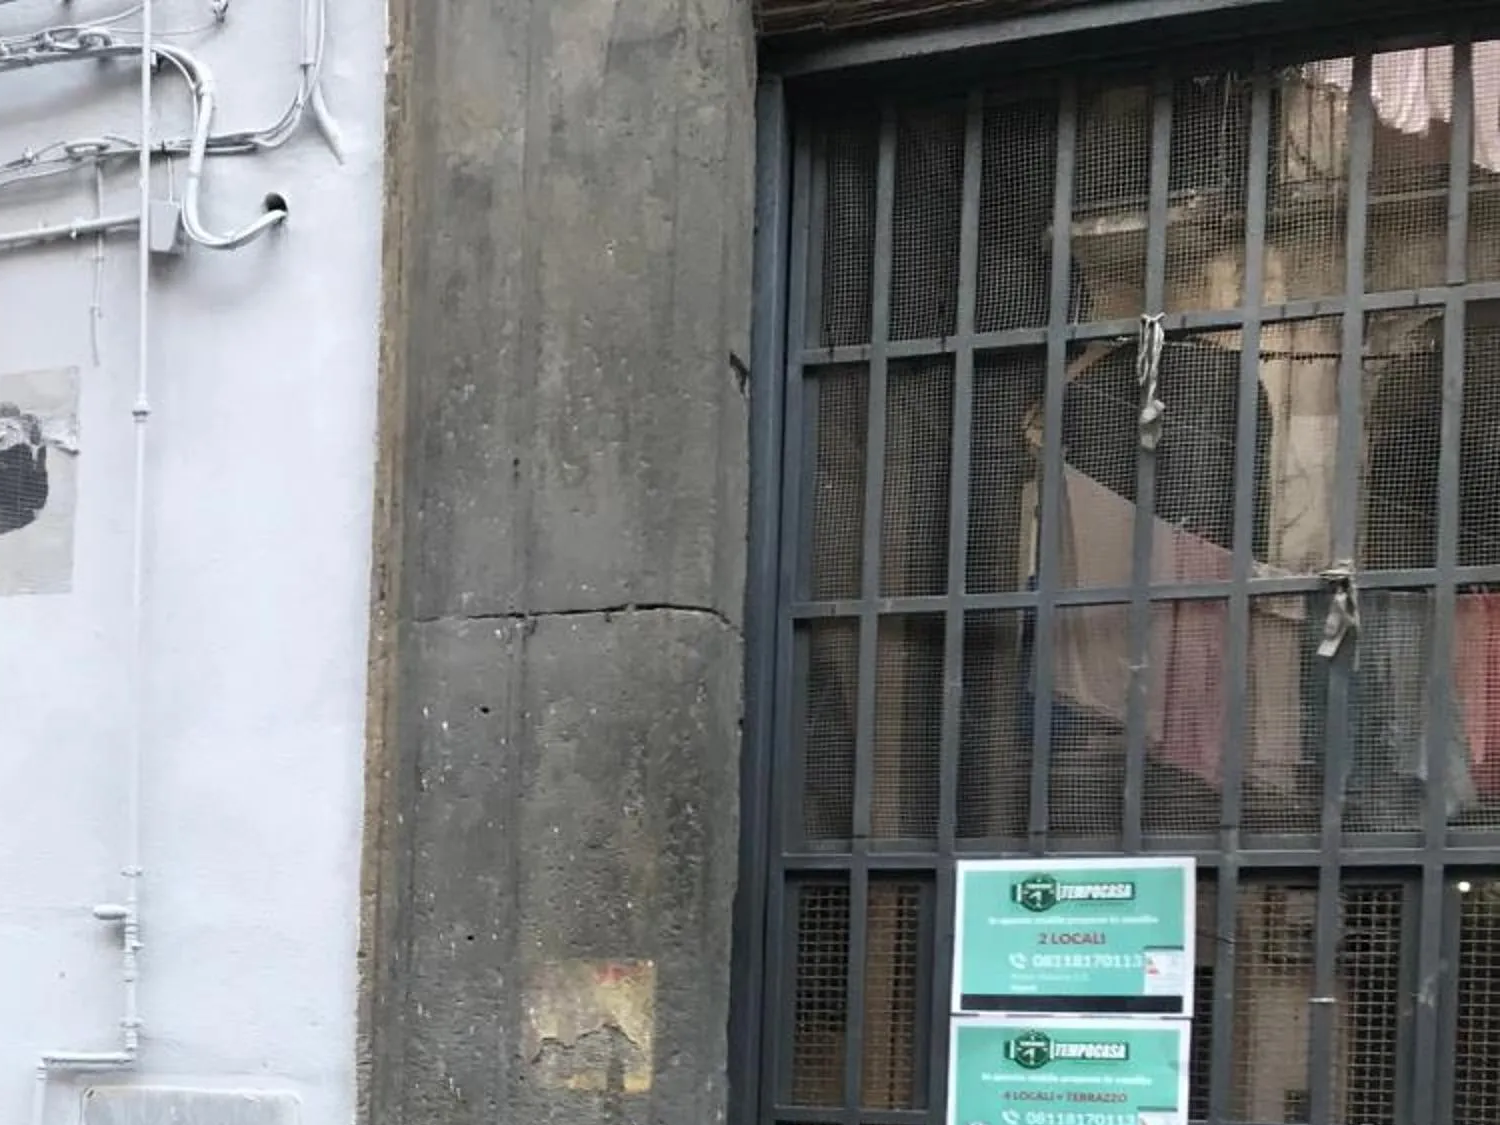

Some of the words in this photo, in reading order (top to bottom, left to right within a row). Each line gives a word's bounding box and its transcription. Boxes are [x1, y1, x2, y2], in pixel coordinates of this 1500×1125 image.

[1059, 883, 1133, 900] TEMPOCASA
[1038, 932, 1049, 945] 2
[1051, 932, 1106, 945] LOCALI
[1054, 1042, 1127, 1060] TEMPOCASA
[1012, 1091, 1054, 1102] LOCALI
[1065, 1092, 1128, 1104] TERRAZZO
